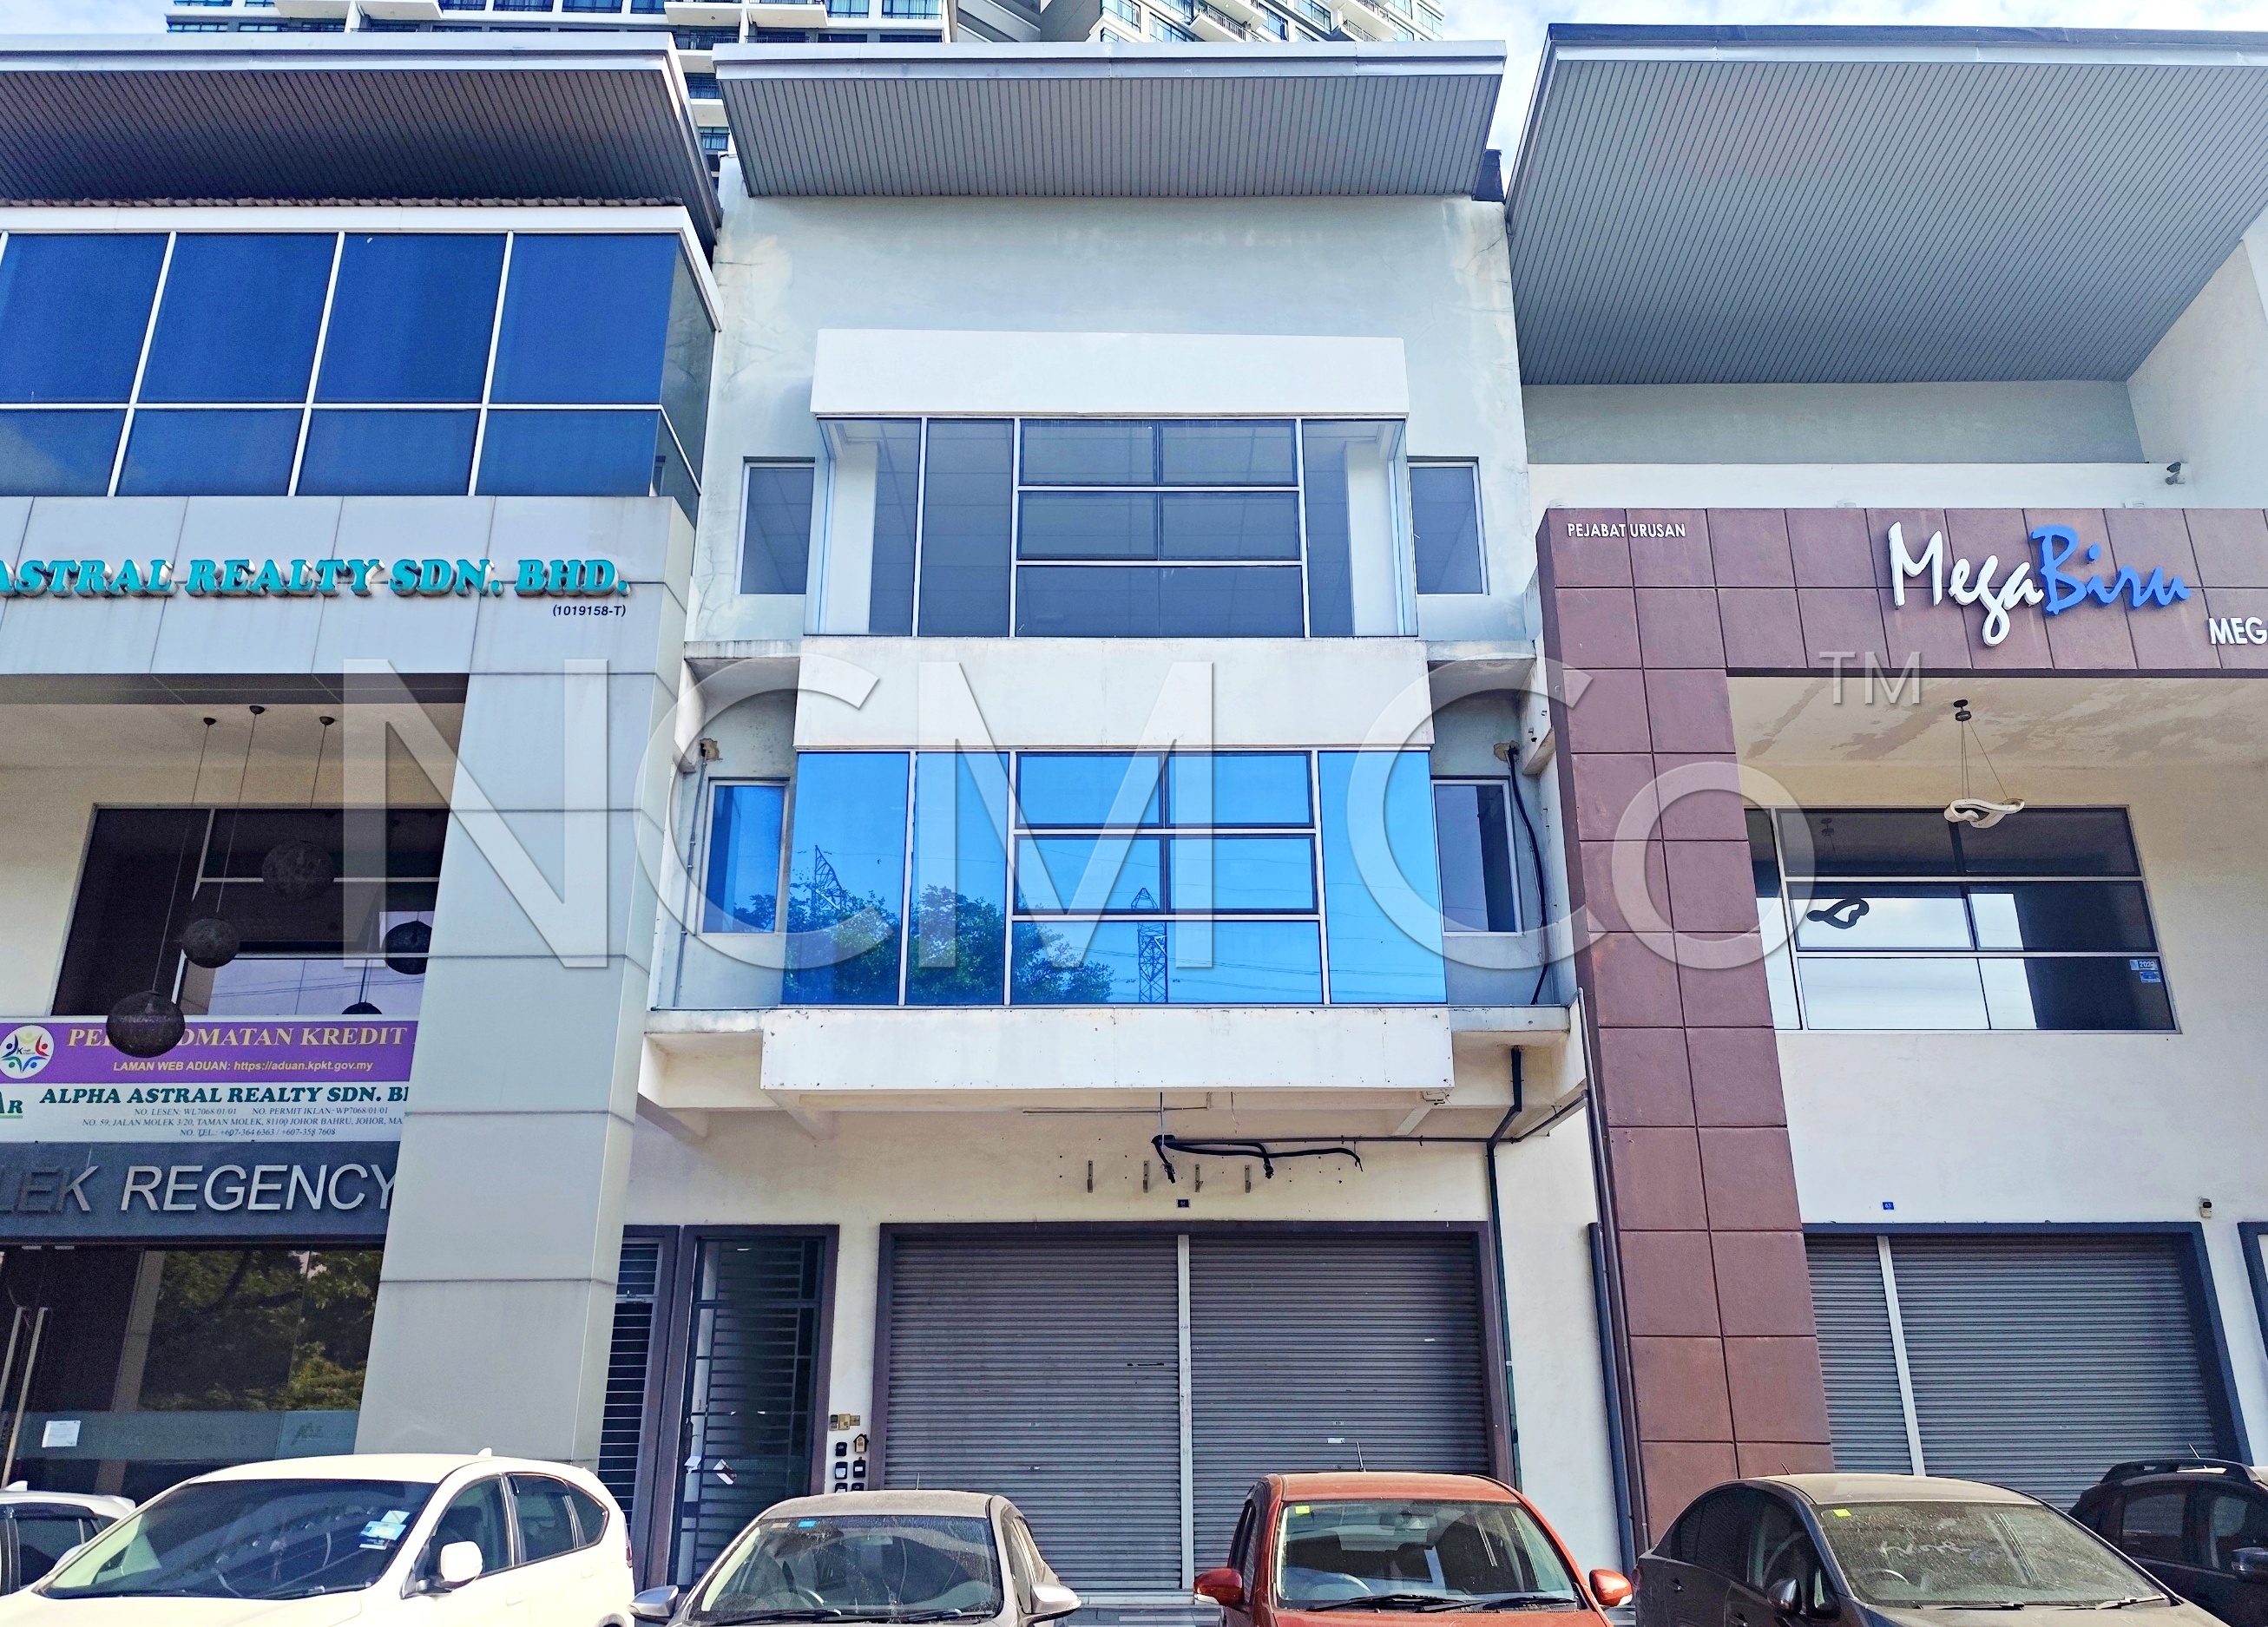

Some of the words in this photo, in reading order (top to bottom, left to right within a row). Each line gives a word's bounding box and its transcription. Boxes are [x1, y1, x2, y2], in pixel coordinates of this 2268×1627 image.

[1567, 523, 1626, 537] PEJABAT
[1630, 523, 1686, 537] URUSAN
[184, 558, 384, 598] REALTY
[388, 558, 503, 598] SDN.
[515, 558, 630, 598] BHD.
[553, 604, 626, 617] (1019158-T)
[2208, 616, 2268, 645] MEG
[299, 1027, 407, 1046] KREDIT
[113, 1061, 155, 1072] LAMAN
[157, 1061, 184, 1071] WEB
[186, 1060, 231, 1071] ADUAN:
[233, 1060, 374, 1073] https://aduan.kpkt.gov.my
[39, 1088, 122, 1104] ALPHA
[127, 1087, 223, 1104] ASTRAL
[227, 1086, 323, 1103] REALTY
[326, 1086, 382, 1102] SDN.
[252, 1107, 267, 1116] NO.
[197, 1118, 228, 1126] TAMAN
[0, 1164, 99, 1213] EK
[120, 1163, 397, 1212] REGENCY
